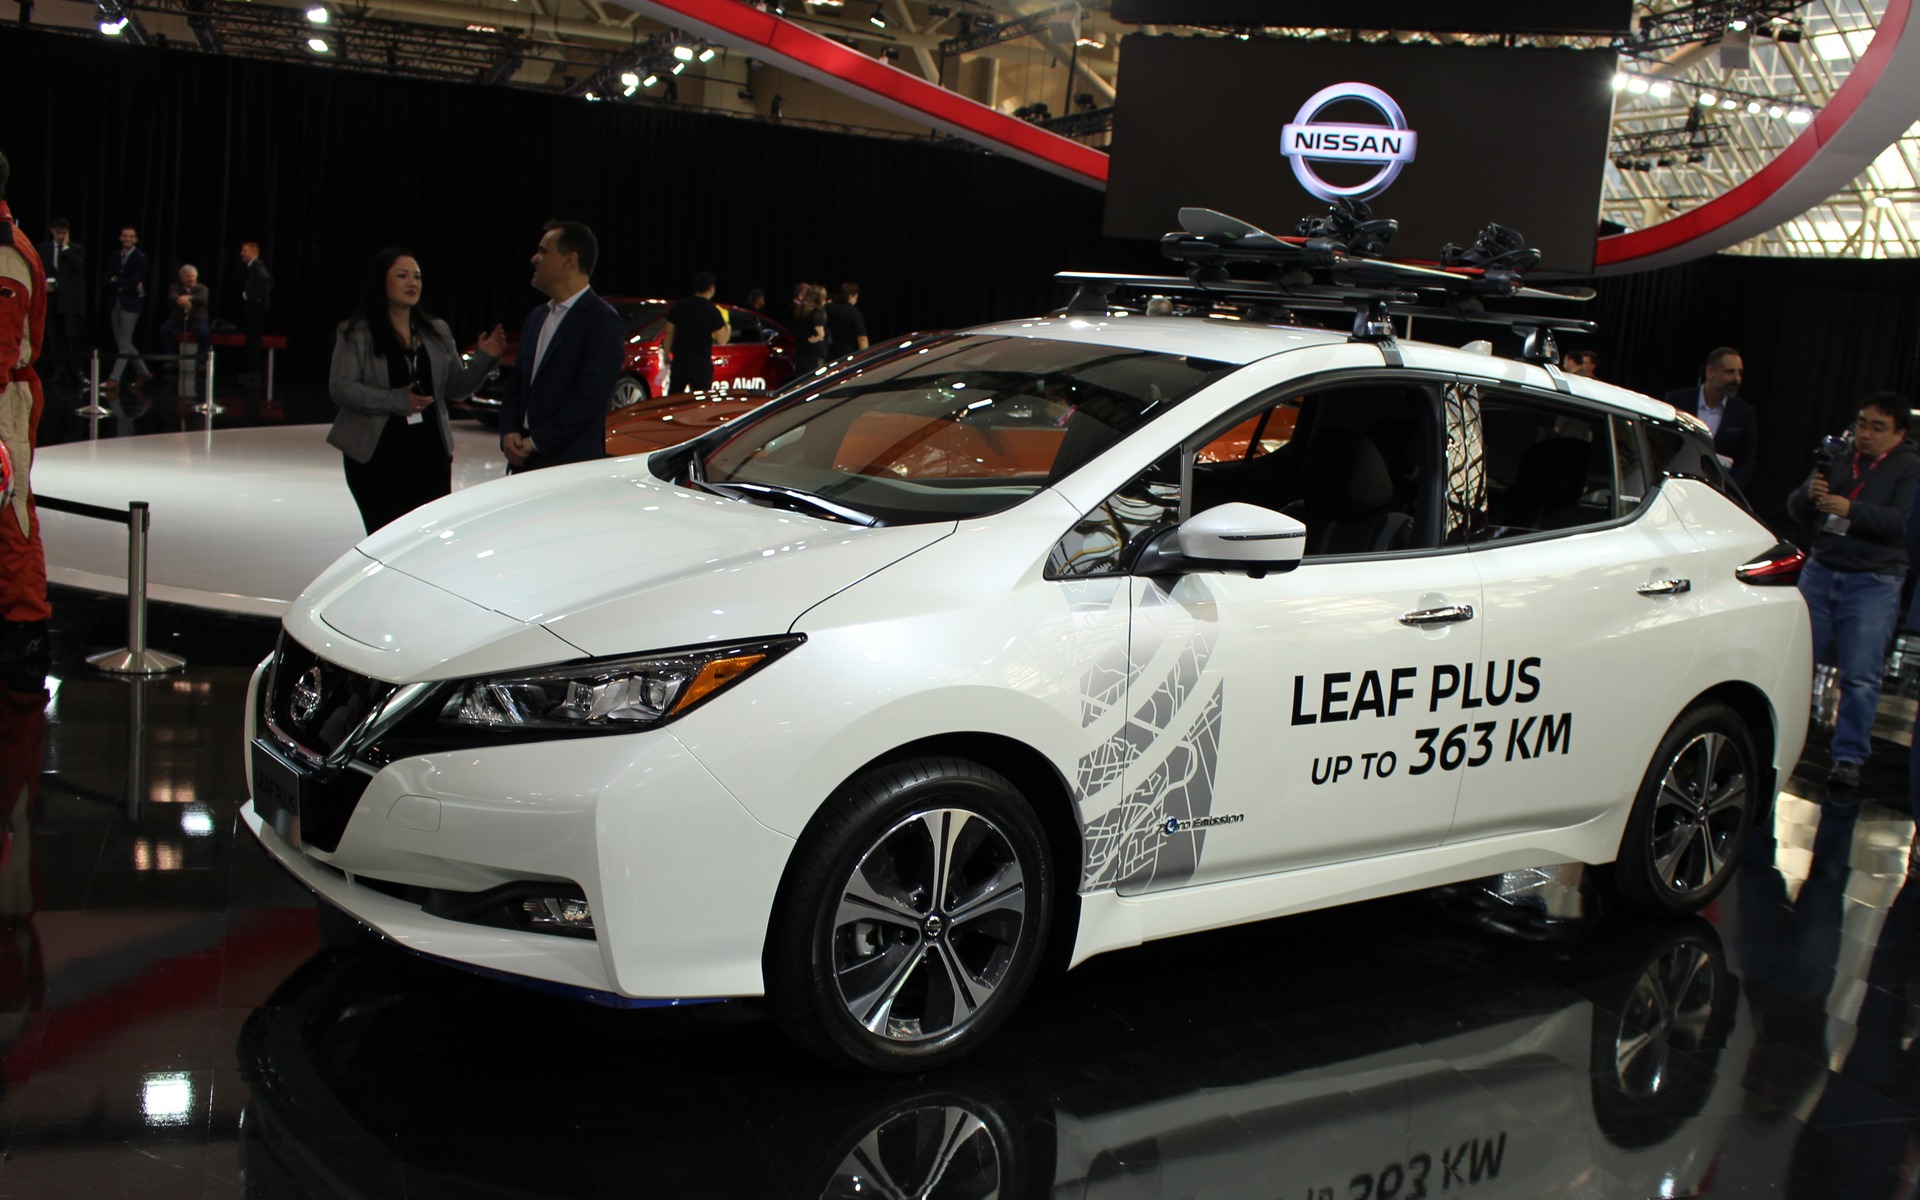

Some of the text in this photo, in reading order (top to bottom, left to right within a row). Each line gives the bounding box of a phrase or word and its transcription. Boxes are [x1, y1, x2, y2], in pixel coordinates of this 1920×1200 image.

[1295, 132, 1401, 154] NISSAN
[1291, 657, 1541, 726] LEAF PLUS
[1311, 712, 1572, 785] UP TO 363 KM
[1193, 813, 1245, 829] Emission
